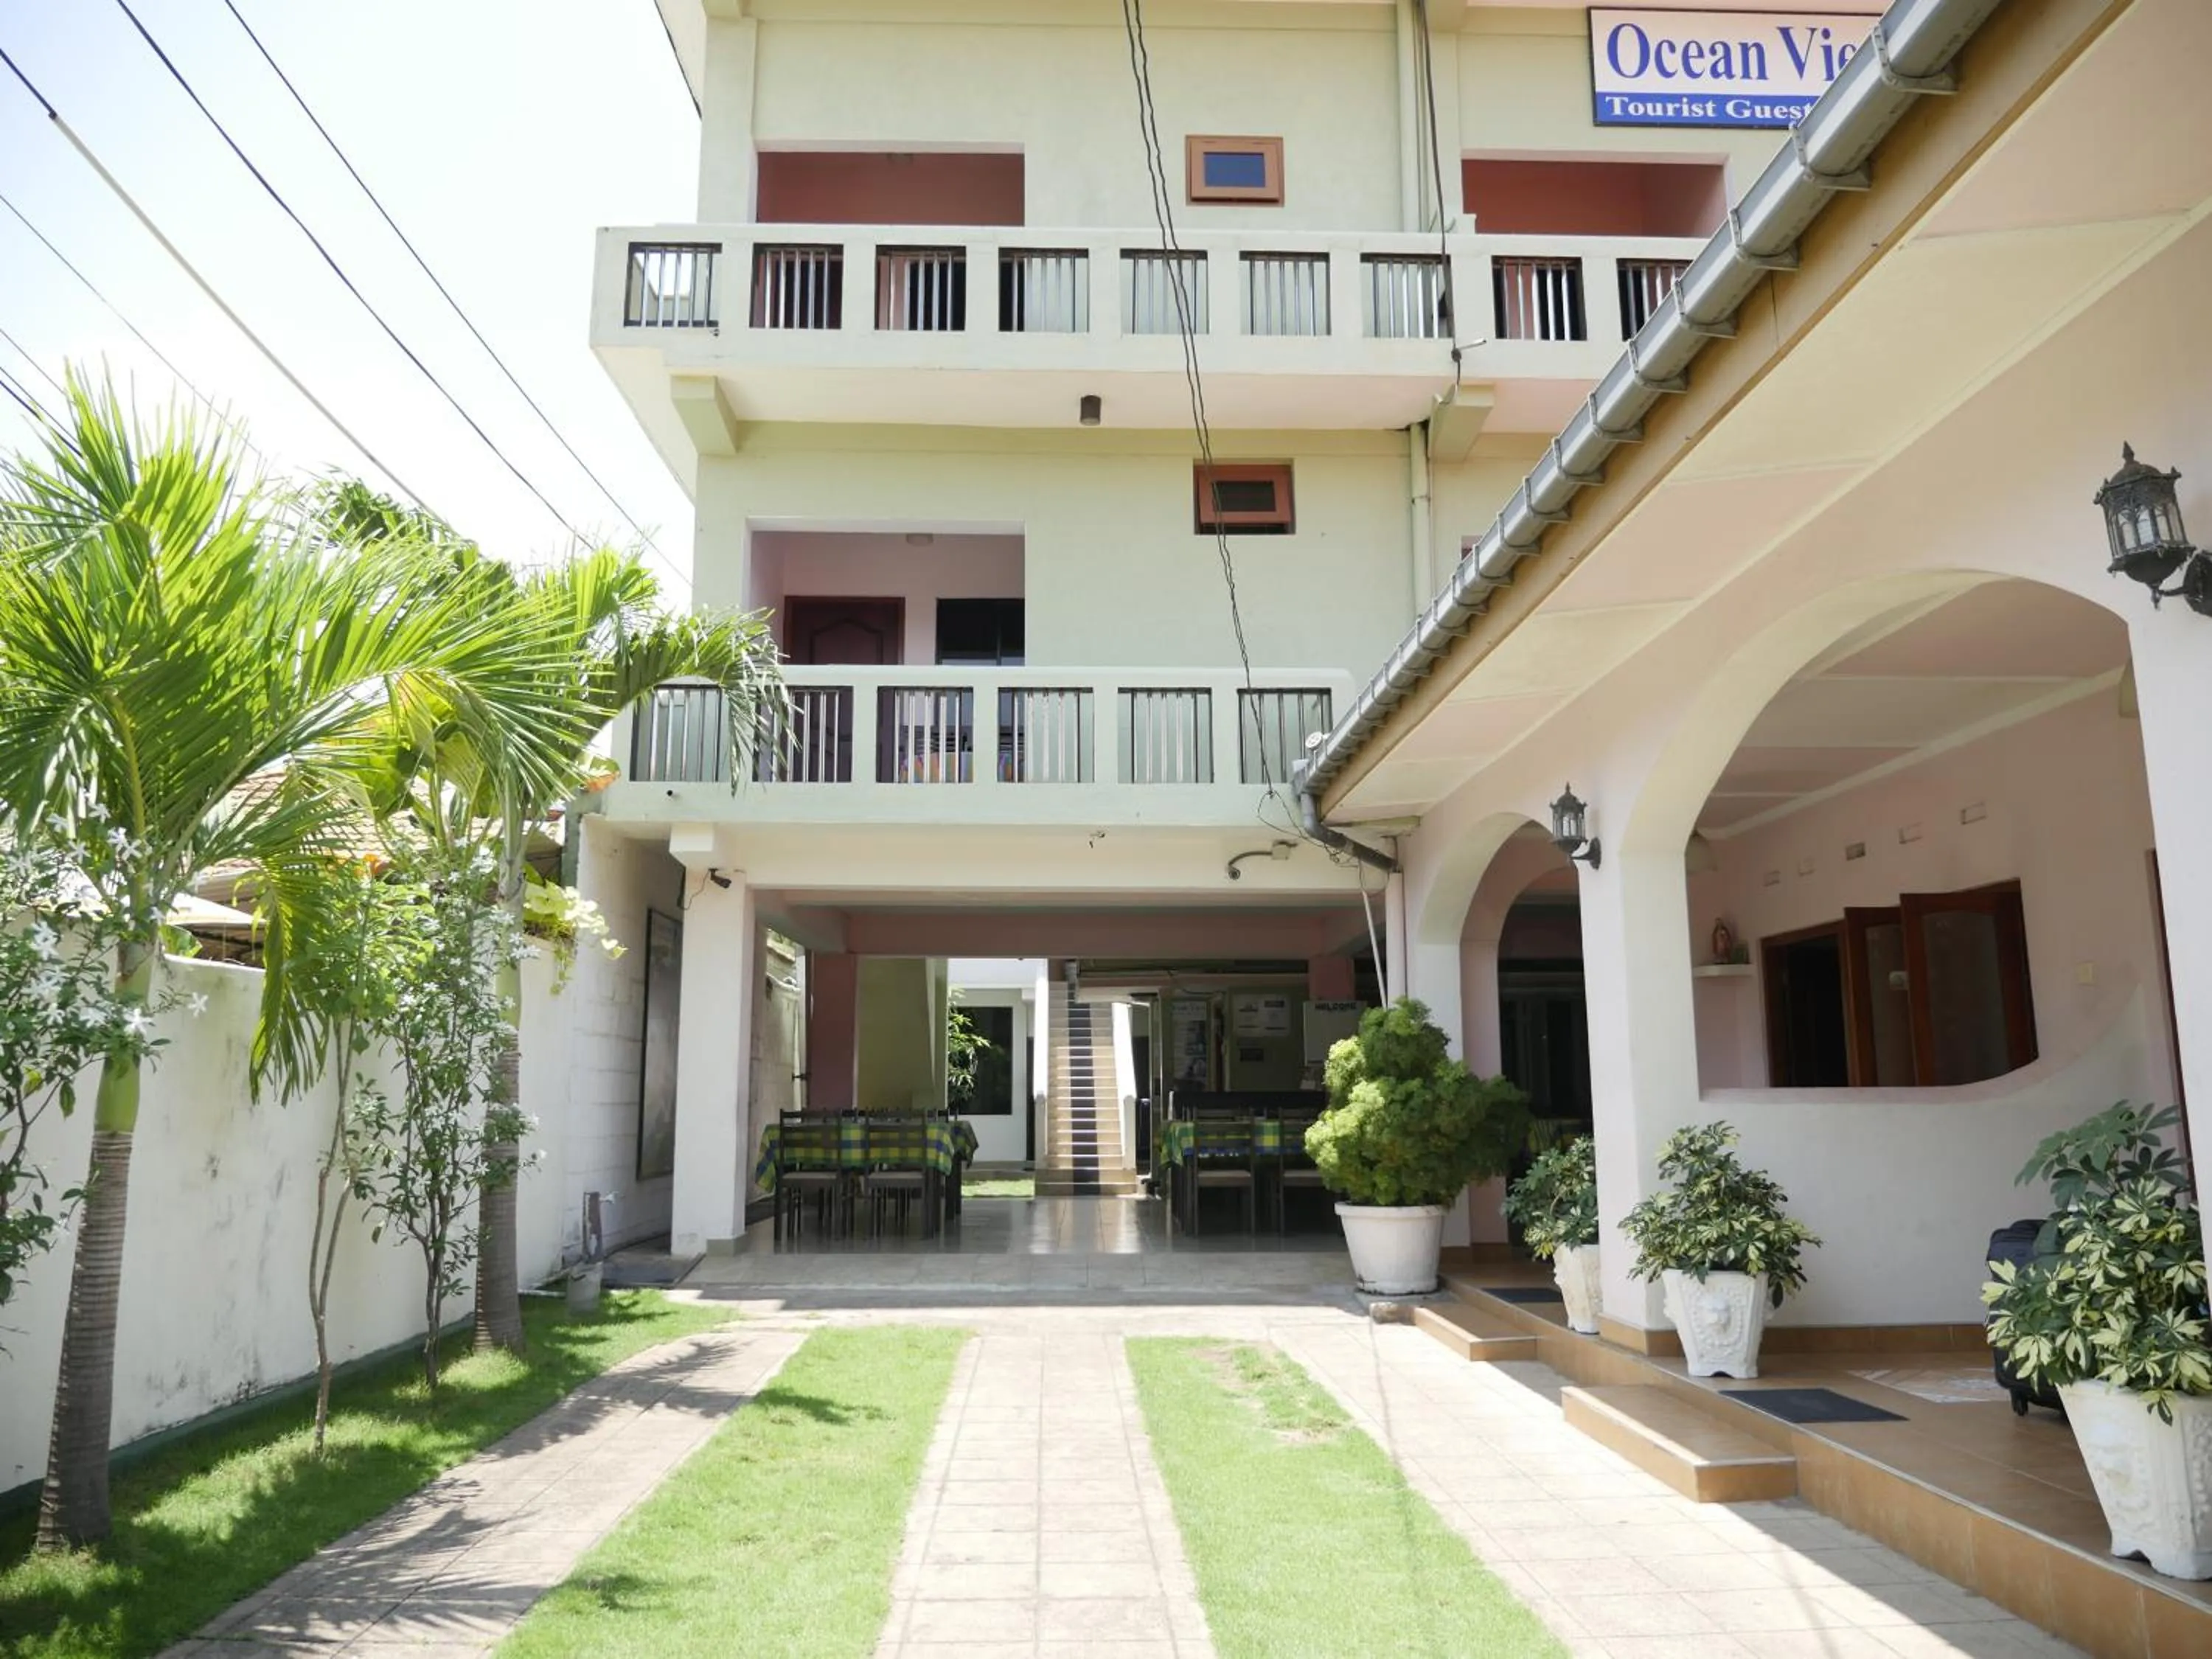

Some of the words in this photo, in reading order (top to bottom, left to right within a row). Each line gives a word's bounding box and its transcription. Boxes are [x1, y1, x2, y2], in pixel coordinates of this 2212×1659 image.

[1607, 23, 1769, 80] Ocean
[1605, 97, 1717, 118] Tourist
[1725, 100, 1812, 119] Guest
